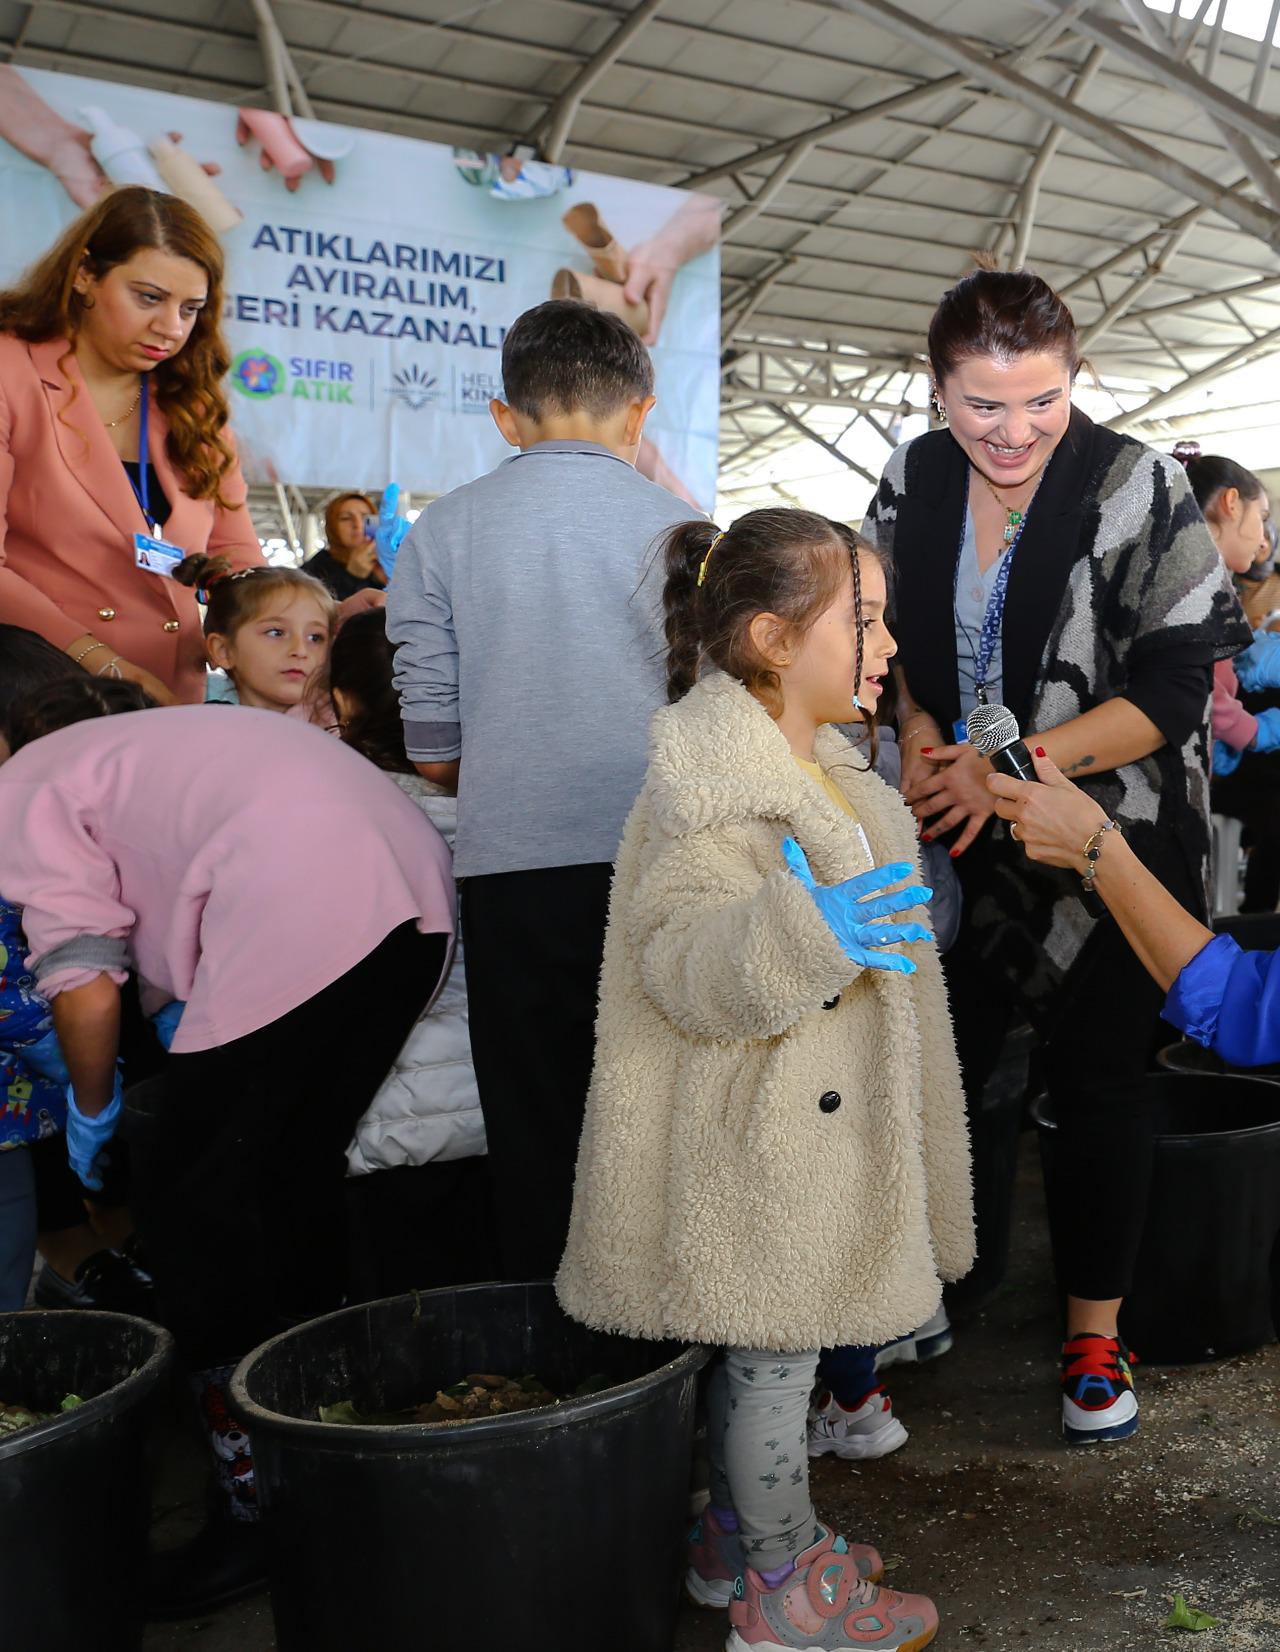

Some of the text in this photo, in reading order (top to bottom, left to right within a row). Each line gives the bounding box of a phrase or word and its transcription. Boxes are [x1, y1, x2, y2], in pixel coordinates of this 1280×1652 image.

[252, 223, 506, 283] ATIKLARIMIZI
[287, 264, 477, 313] AYIRALIM,
[289, 356, 353, 382] SIFIR
[291, 380, 354, 405] ATIK
